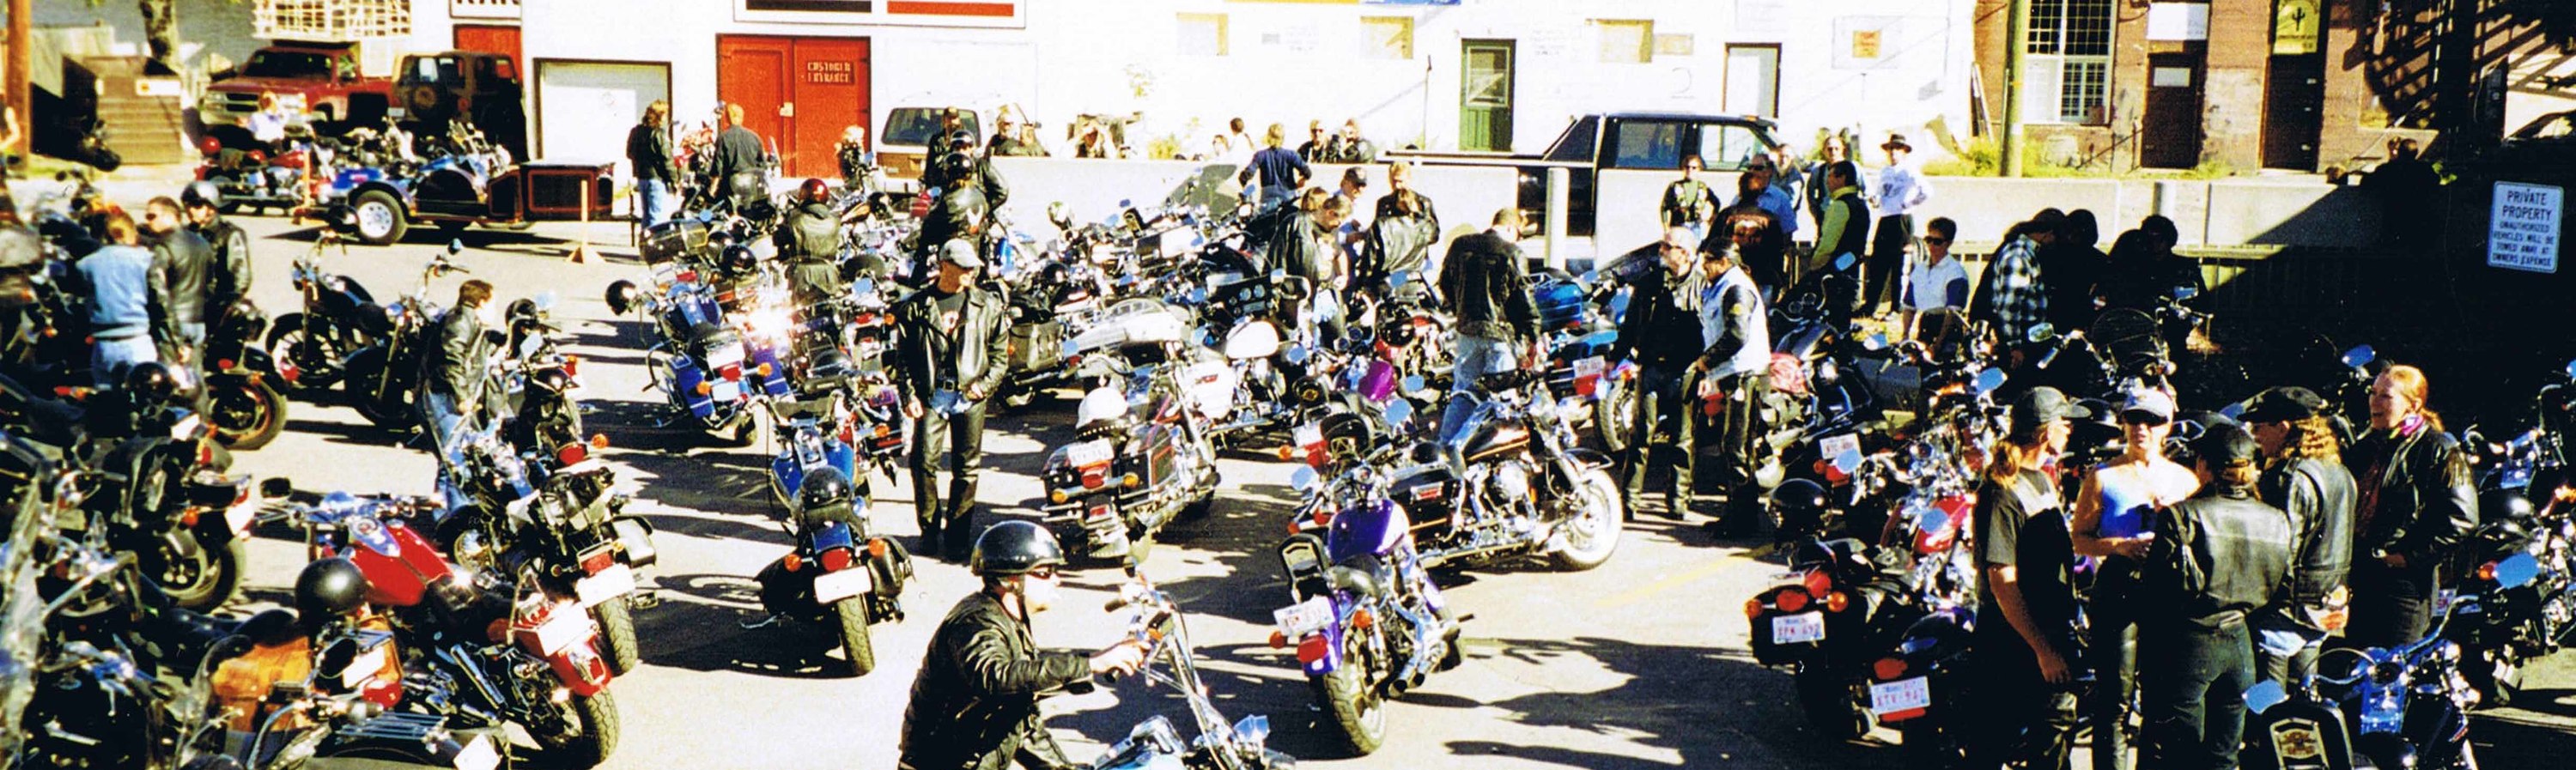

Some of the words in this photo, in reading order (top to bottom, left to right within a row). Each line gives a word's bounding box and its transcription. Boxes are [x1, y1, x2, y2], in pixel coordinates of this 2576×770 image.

[2507, 191, 2547, 205] PRIVATE
[2502, 205, 2553, 221] PROPERTY
[2500, 221, 2550, 233] UNAUTHORIZED
[2494, 231, 2524, 241] VEHICLES
[2527, 233, 2543, 243] WILL
[2545, 236, 2555, 245] BE
[2496, 242, 2518, 252] TOWED
[2521, 245, 2538, 254] AWAY
[2520, 255, 2552, 266] EXPENSE
